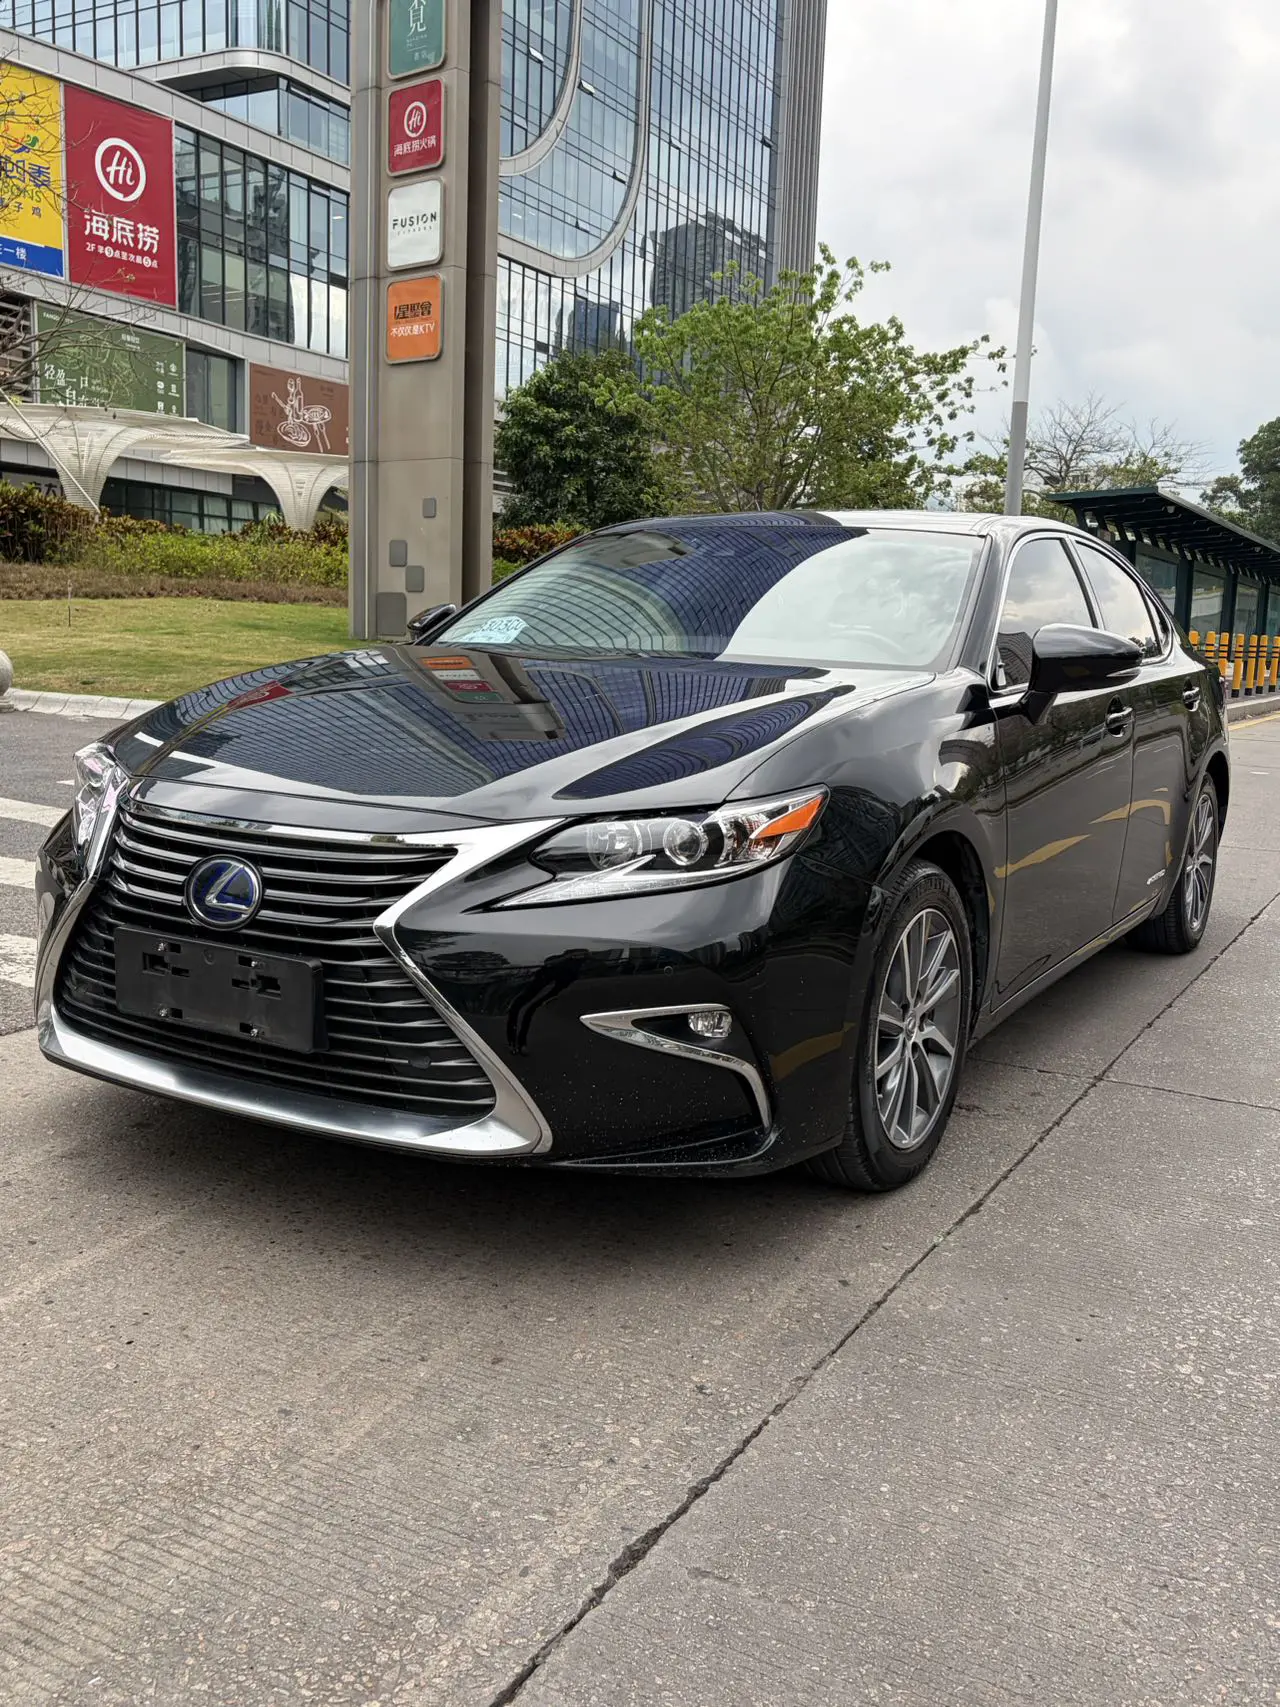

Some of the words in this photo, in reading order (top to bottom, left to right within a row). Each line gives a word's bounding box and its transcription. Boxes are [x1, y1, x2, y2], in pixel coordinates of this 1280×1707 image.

[408, 108, 422, 131] Hi
[105, 150, 135, 186] Hi
[84, 209, 160, 254] 海底捞
[392, 211, 437, 230] FUSION
[86, 242, 96, 252] 2F
